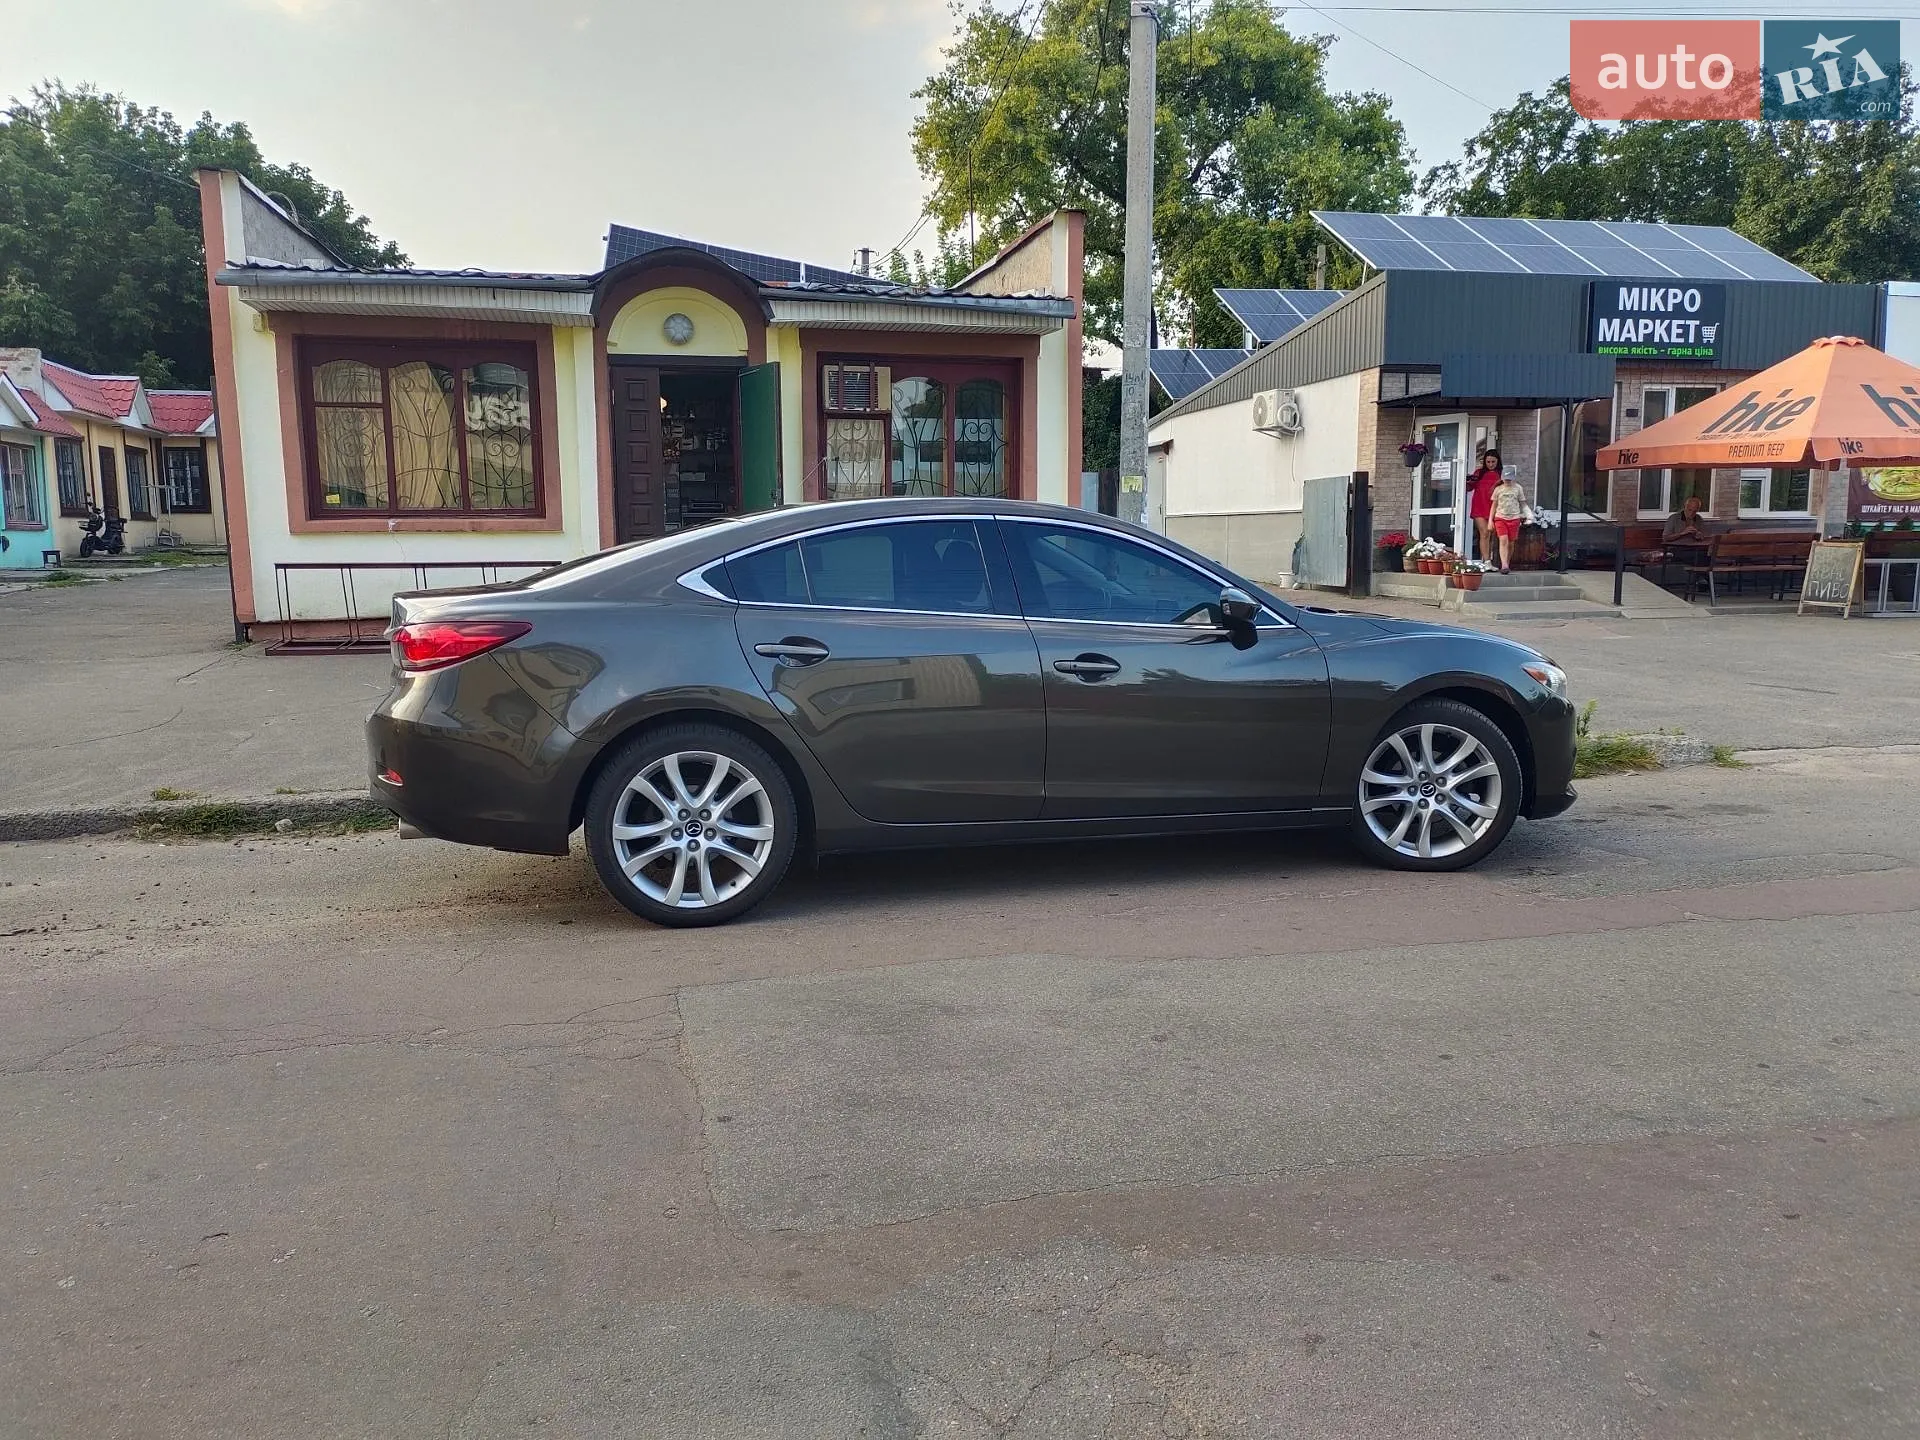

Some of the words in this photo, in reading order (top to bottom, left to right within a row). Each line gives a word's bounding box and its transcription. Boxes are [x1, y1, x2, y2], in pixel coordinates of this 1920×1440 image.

[1618, 287, 1701, 312] МІКРО
[1598, 318, 1700, 343] МАРКЕТ
[1598, 345, 1629, 355] висока
[1631, 345, 1658, 355] якість
[1667, 346, 1692, 358] гарна
[1694, 346, 1713, 357] ціна
[1701, 388, 1816, 434] hike
[1728, 444, 1765, 458] PREMIUM
[1767, 443, 1785, 456] BEER
[1837, 437, 1864, 454] hike
[1618, 449, 1639, 464] hike
[1808, 580, 1850, 600] ПИВО
